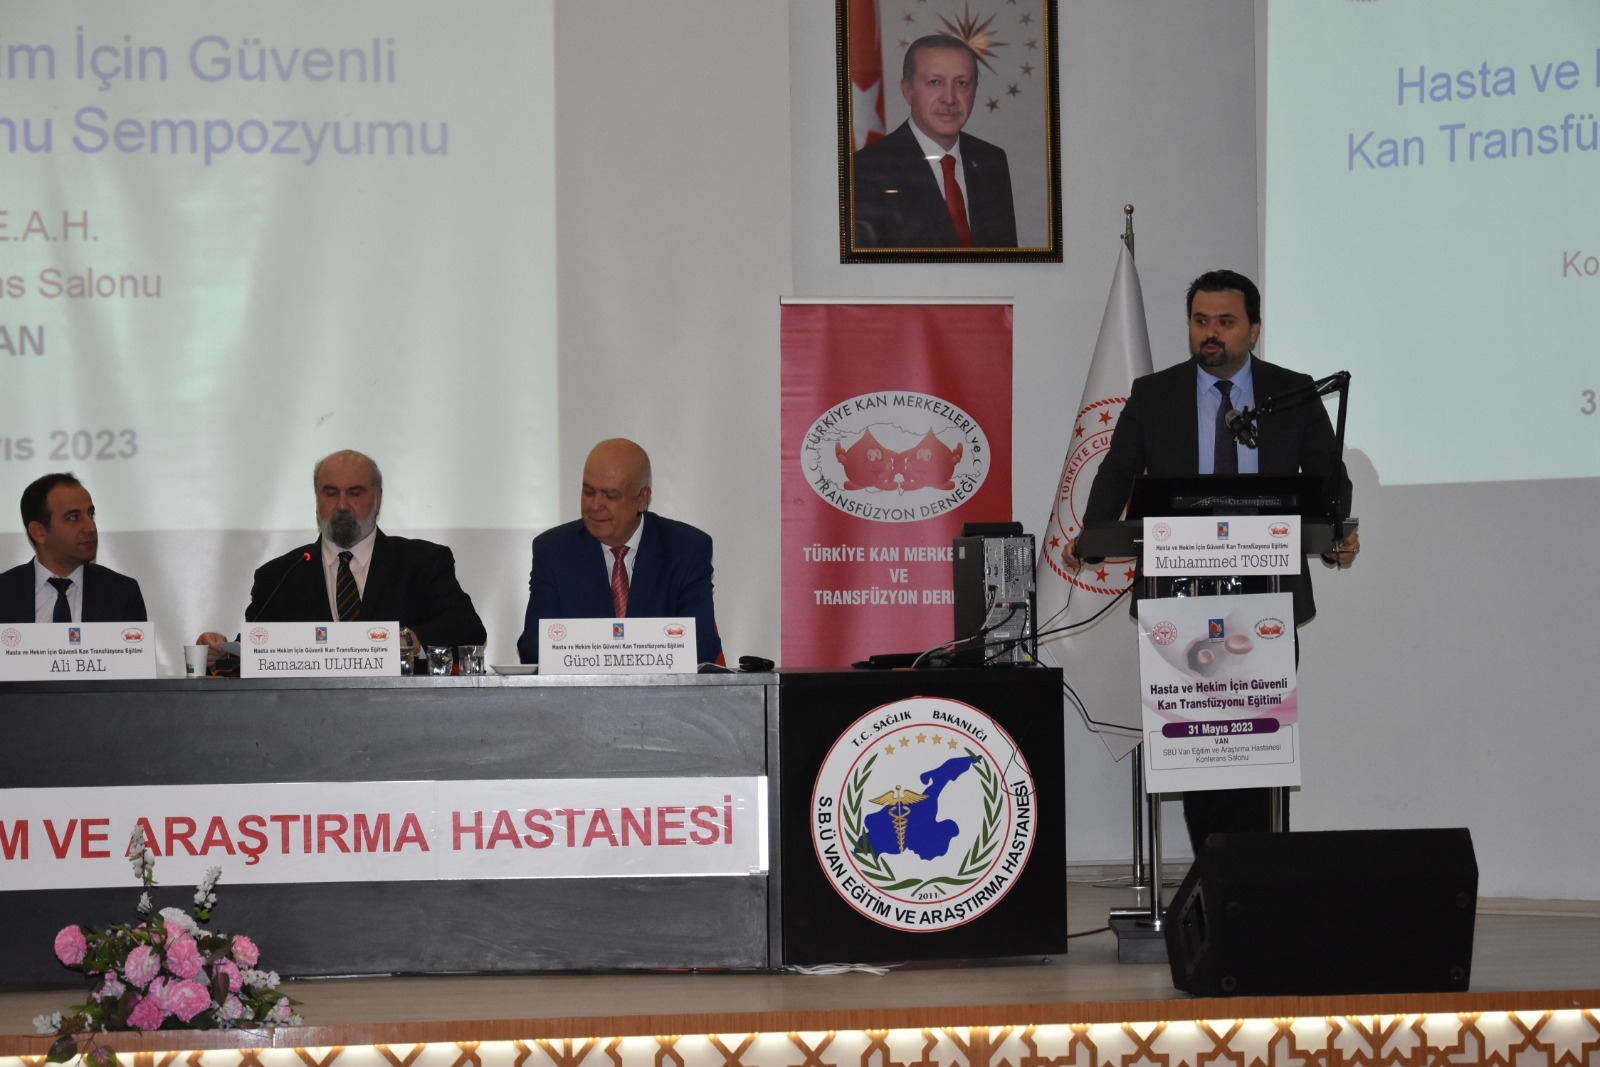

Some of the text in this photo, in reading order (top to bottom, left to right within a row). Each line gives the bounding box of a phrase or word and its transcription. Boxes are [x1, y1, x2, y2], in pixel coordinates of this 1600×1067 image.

[0, 25, 396, 91] m İçin Güvenli
[1397, 60, 1516, 106] Hasta
[1530, 60, 1580, 93] ve
[72, 106, 450, 167] Sempozyumu
[1348, 113, 1599, 171] Kan Transfü
[0, 267, 163, 300] s Salonu
[1580, 389, 1600, 416] 3
[806, 394, 982, 453] TÜRKİYE KAN MERKEZLERİ ve
[0, 428, 139, 462] ıs 2023
[1092, 434, 1116, 449] CU
[814, 475, 978, 521] TRANSFÜZYON DERNEĞİ
[803, 544, 864, 562] TÜRKİYE
[870, 547, 899, 562] KAN
[1155, 554, 1290, 569] Muhammed TOSUN
[890, 568, 909, 583] VE
[814, 587, 954, 605] TRANSFÜZYON DER
[50, 659, 106, 673] Ali BAL
[258, 657, 384, 671] Ramazan ULUHAN
[563, 654, 674, 669] Gürol EMEKDAŞ
[1150, 678, 1288, 695] Hasta ve Hekim İçin Güvenli
[1157, 694, 1282, 710] Kan Transfüzyonu Eğitimi
[851, 710, 988, 748] T.C. SAĞLIK BAKANLIĞI
[1188, 722, 1253, 736] 31 Mayıs 2023
[1163, 748, 1177, 756] SBÜ
[1178, 748, 1190, 756] Van
[1251, 744, 1281, 752] Hastanesi
[1228, 754, 1249, 762] Salonu
[43, 818, 110, 859] VE
[125, 812, 430, 866] ARAŞTIRMA
[451, 795, 733, 851] HASTANESİ
[823, 843, 848, 878] VAN
[841, 875, 892, 918] EĞİTİM
[895, 907, 917, 925] VE
[919, 874, 1008, 925] ARAŞTIRMA
[1002, 779, 1031, 874] HASTANESİ
[918, 892, 939, 900] 2011
